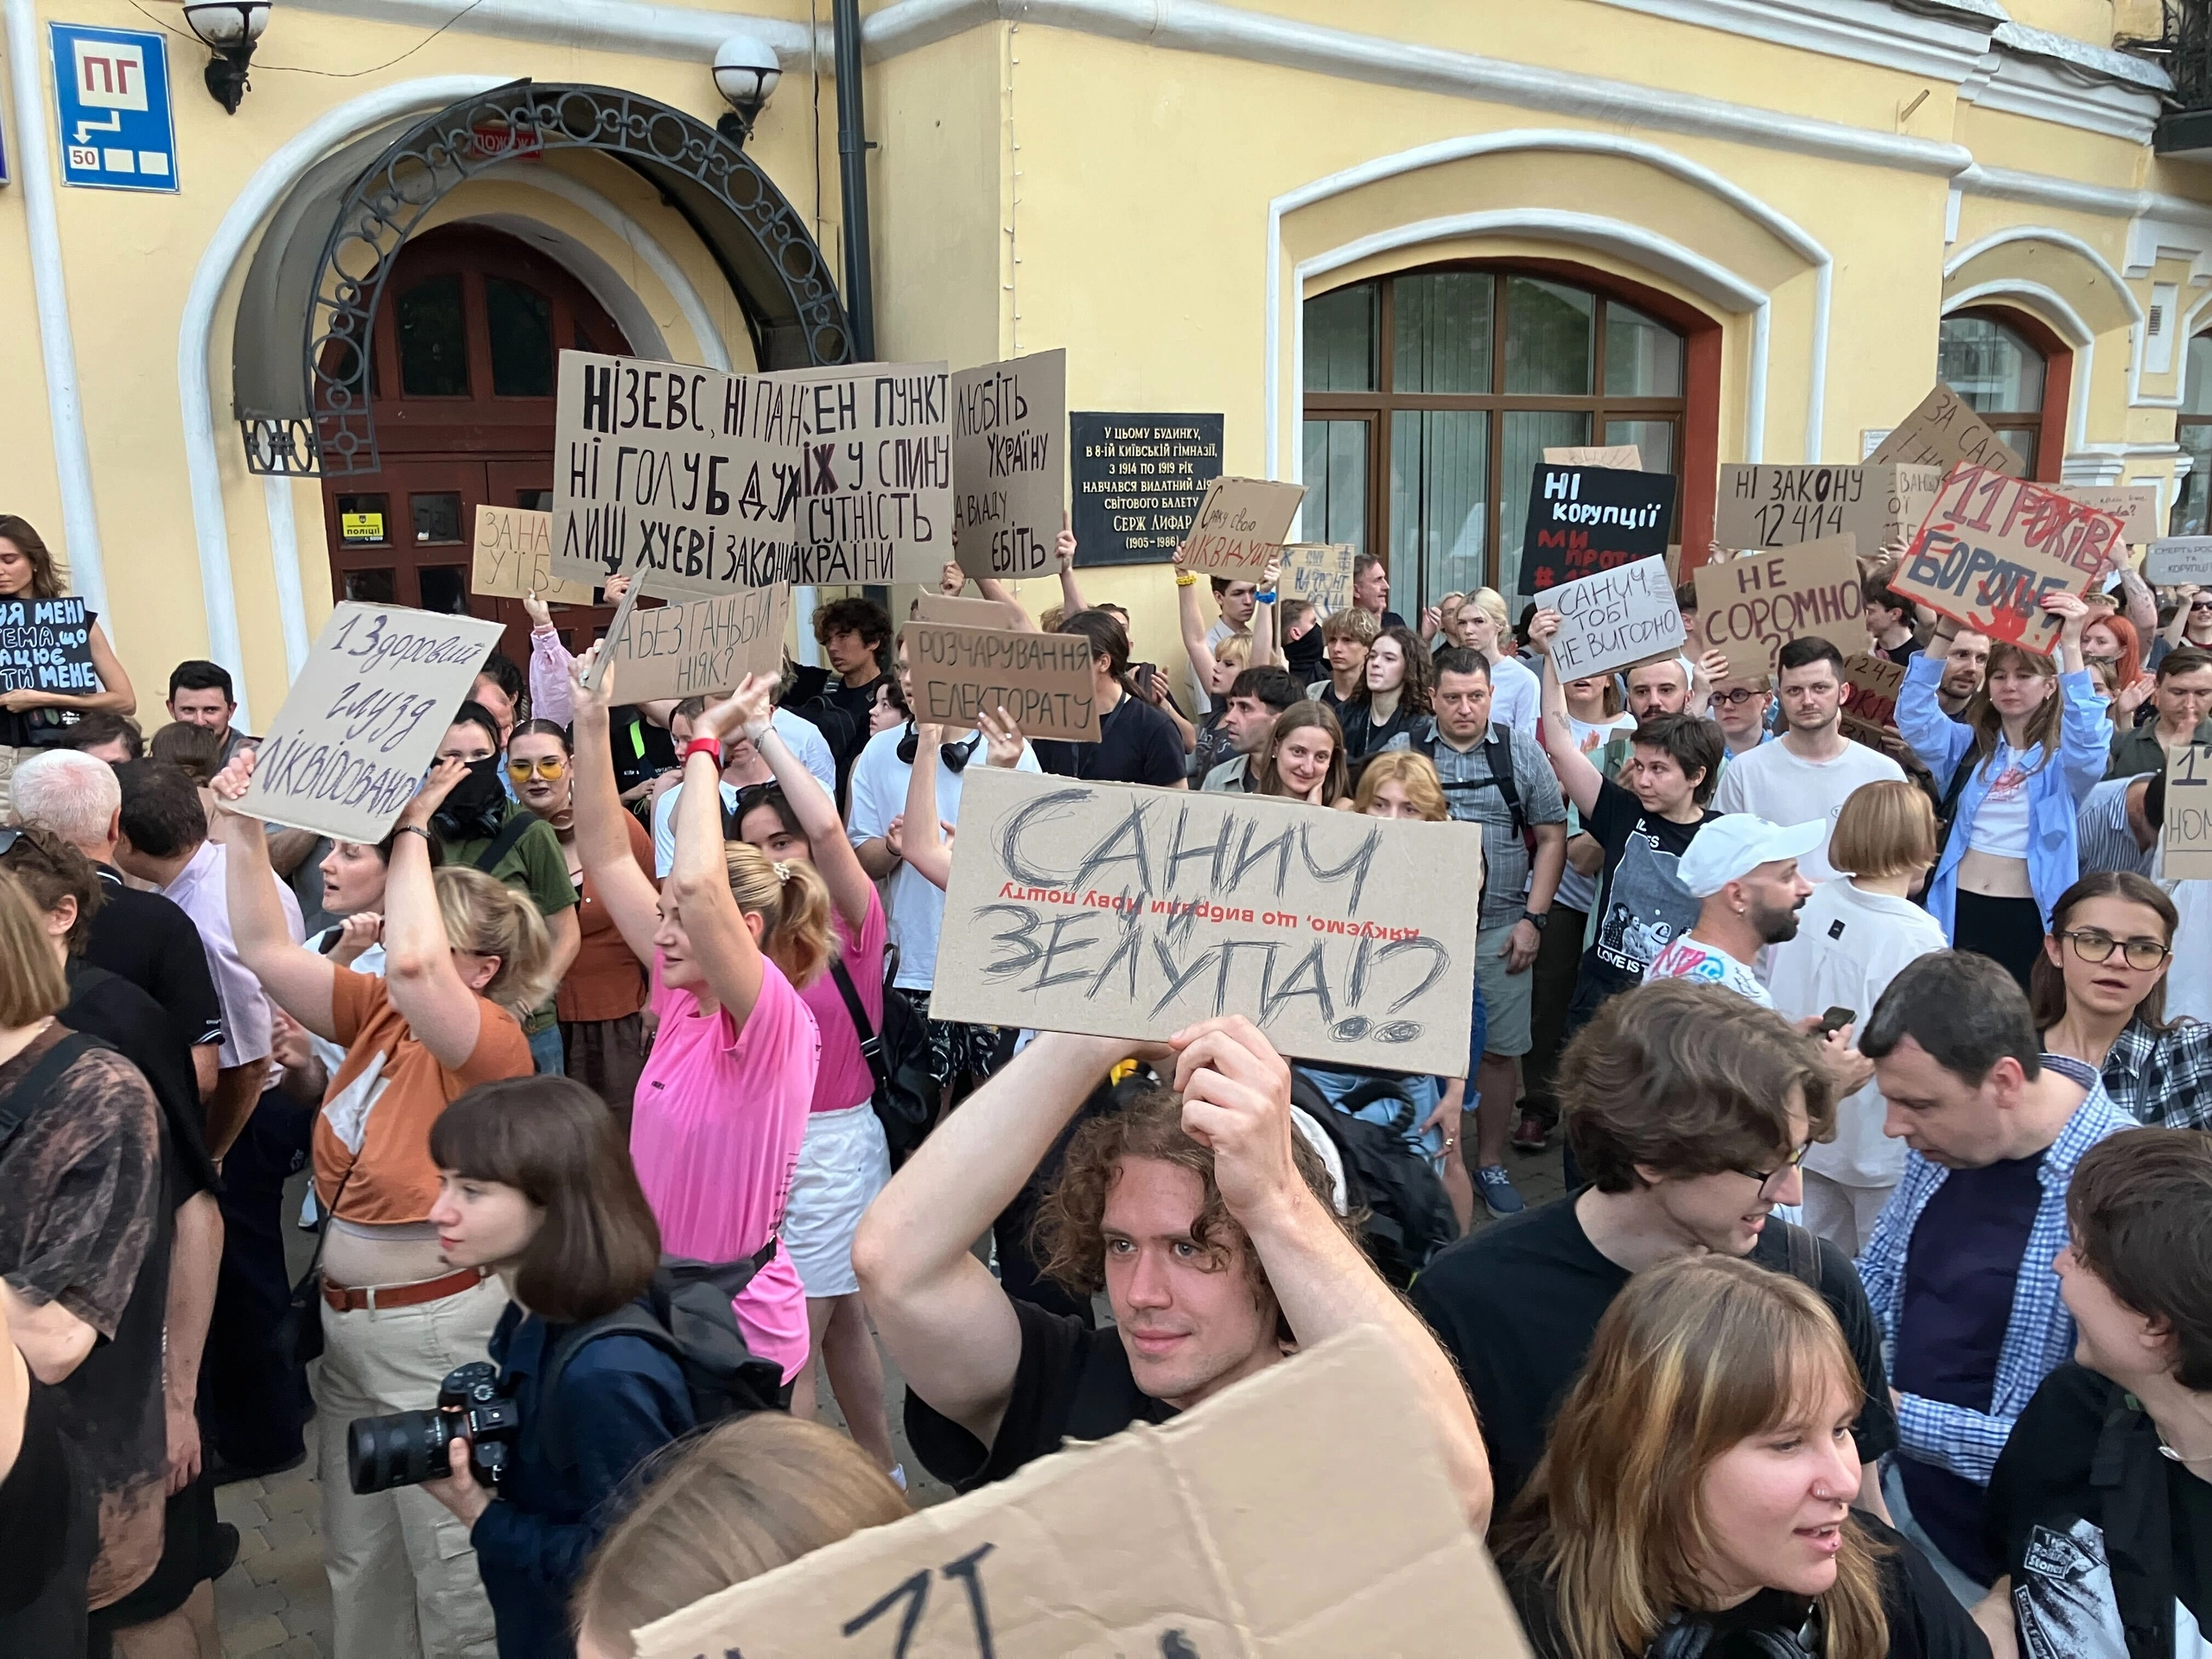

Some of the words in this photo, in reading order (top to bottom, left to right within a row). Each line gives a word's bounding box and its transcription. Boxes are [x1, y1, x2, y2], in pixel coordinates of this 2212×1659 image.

[83, 55, 138, 94] ПГ
[72, 149, 96, 167] 50
[874, 374, 949, 429] ПУНКТ
[956, 371, 1028, 440] ЛЮБІТЬ
[1925, 394, 1959, 427] ЗА
[1086, 446, 1093, 457] В
[1118, 442, 1170, 457] КИЇВСЬКІЙ
[1173, 443, 1217, 459] ГІМНАЗІЇ,
[1104, 427, 1112, 439] У
[1115, 427, 1150, 441] ЦЬОМУ
[1154, 428, 1201, 441] БУДИНКУ,
[848, 442, 863, 491] У
[878, 435, 950, 491] СПИНУ
[987, 429, 1048, 478] УКРАЇНУ
[1119, 463, 1137, 474] 1914
[1141, 463, 1154, 474] ПО
[1158, 463, 1175, 474] 1919
[1179, 461, 1193, 474] РІК
[570, 437, 601, 499] НІ
[616, 447, 729, 517] ГОЛУБ
[1083, 481, 1137, 493] НАВЧАВСЯ
[1141, 477, 1192, 493] ВИДАТНИЙ
[1544, 473, 1580, 500] НІ
[1736, 467, 1758, 499] НІ
[1770, 468, 1863, 502] ЗАКОНУ
[808, 491, 932, 545] СУТНІСТЬ
[967, 491, 1007, 529] ВЛАДУ
[1104, 496, 1159, 510] СВІТОВОГО
[1162, 497, 1199, 508] БАЛЕТУ
[563, 502, 626, 576] ЛИШ
[1113, 515, 1146, 531] СЕРЖ
[1151, 514, 1192, 531] ЛИФАР
[1537, 529, 1588, 550] МИ
[1754, 504, 1842, 547] 12414
[1566, 549, 1649, 570] ПРОТ
[1738, 558, 1787, 594] НЕ
[35, 600, 85, 625] МЕНІ
[639, 606, 683, 659] БЕЗ
[689, 588, 772, 652] ГАНЬБИ
[1573, 596, 1629, 632] ТОБІ
[1706, 580, 1862, 645] СОРОМНО
[918, 631, 1090, 671] РОЗЧАРУВАННЯ
[1552, 638, 1583, 671] НЕ
[1587, 609, 1676, 658] ВИГОДНО
[39, 662, 96, 688] МЕНЕ
[677, 647, 734, 692] НІЯК?
[928, 681, 1093, 729] ЕЛЕКТОРАТУ
[991, 788, 1384, 917] САНИЧ
[999, 881, 1076, 905] пошту
[1262, 911, 1297, 931] що
[1306, 915, 1420, 944] дякуємо,
[1598, 947, 1625, 969] LOVE
[1627, 960, 1640, 974] IS
